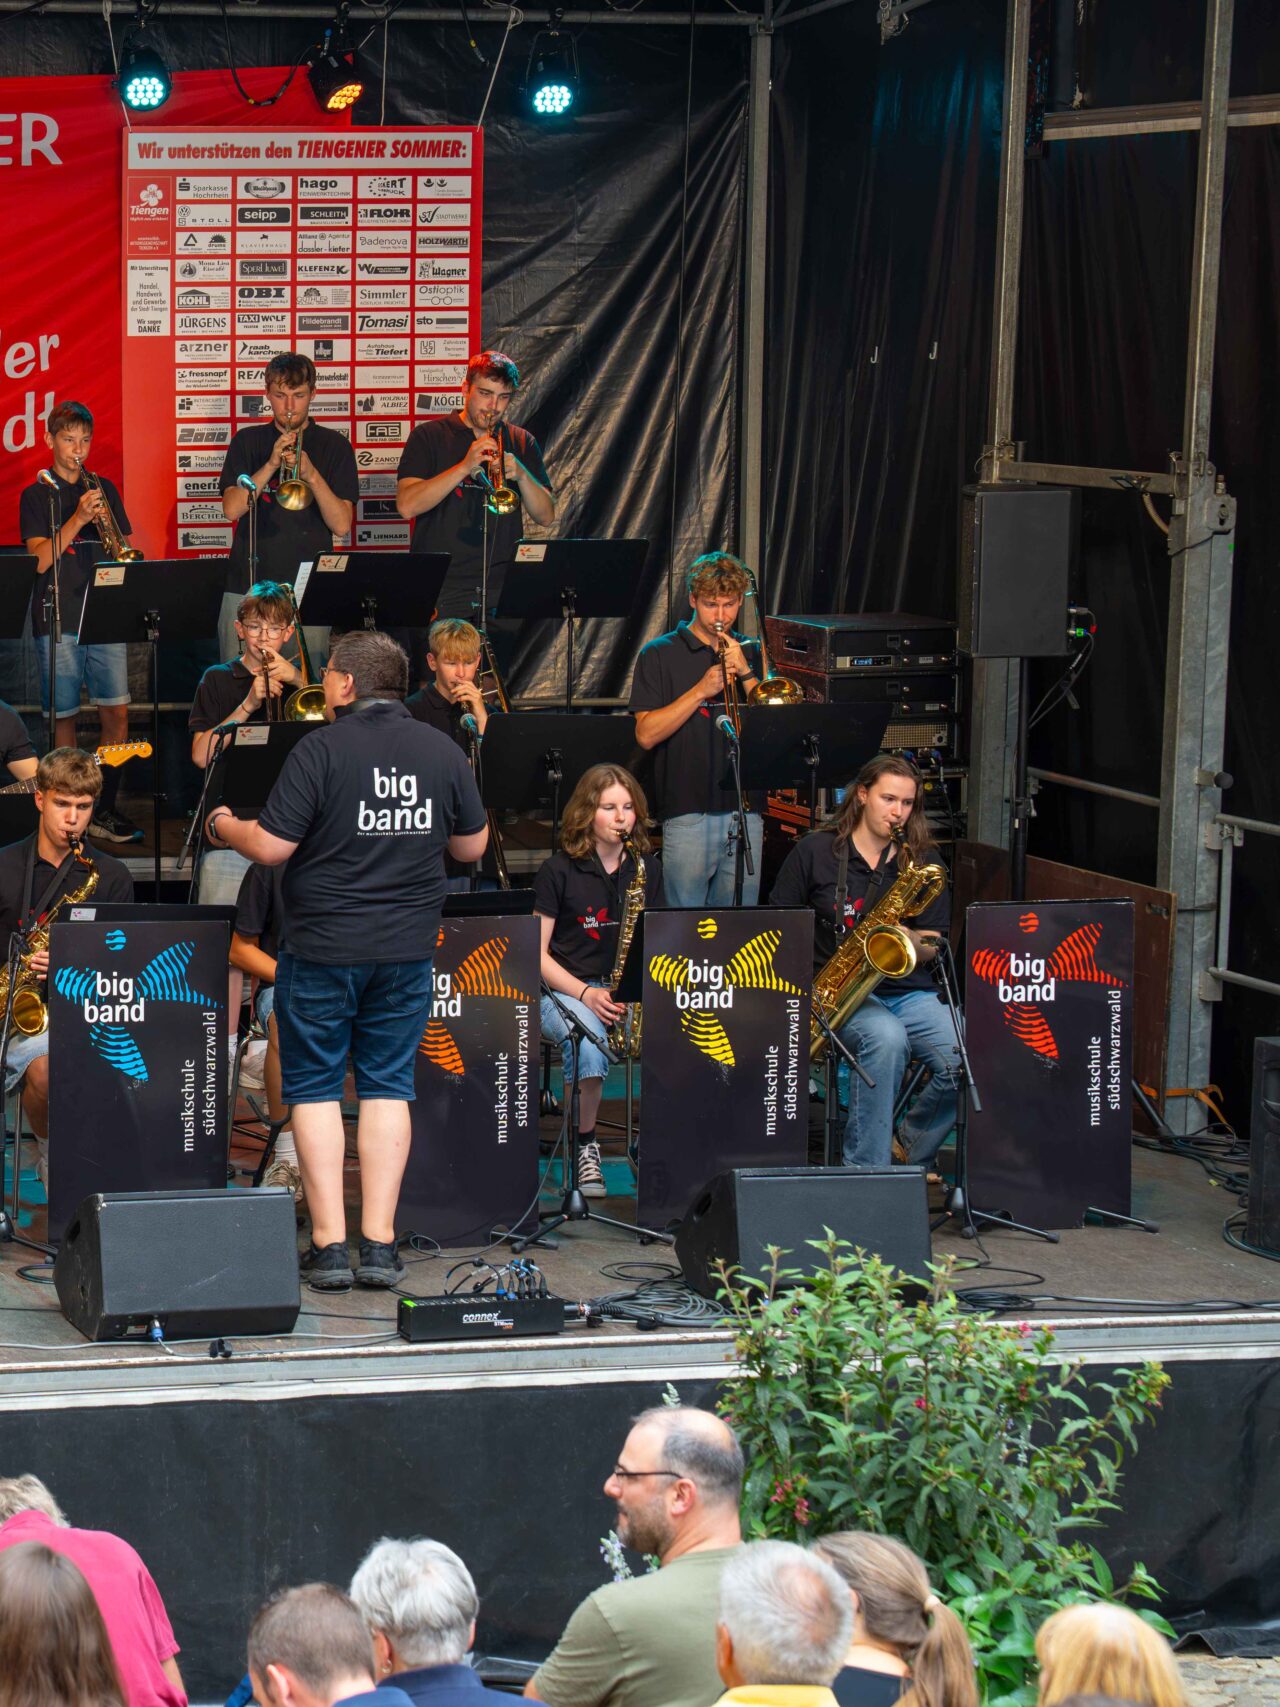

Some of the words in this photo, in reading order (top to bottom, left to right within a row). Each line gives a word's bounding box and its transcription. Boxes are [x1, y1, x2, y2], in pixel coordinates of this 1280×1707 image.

[137, 142, 163, 158] Wir
[167, 142, 260, 159] unterstützen
[265, 143, 292, 158] den
[297, 139, 387, 158] TIENGENER
[390, 139, 467, 158] SOMMER:
[300, 178, 338, 190] hago
[130, 205, 169, 217] Tiengen
[244, 209, 277, 221] seipp
[310, 210, 346, 218] SCHLEITH
[369, 208, 411, 218] FLOHR
[328, 240, 350, 252] kiefer
[418, 238, 468, 246] HOLZWARTH
[432, 266, 466, 277] Wagner
[238, 287, 285, 298] OBI
[360, 289, 407, 299] Simmler
[419, 285, 464, 295] Ostioptik
[179, 315, 227, 328] JÜRGENS
[238, 314, 259, 322] TAXI
[358, 315, 408, 332] Tomasi
[416, 316, 433, 325] sto
[180, 343, 228, 352] arzner
[189, 370, 227, 378] fressnapf
[178, 428, 228, 442] 2000
[367, 423, 401, 436] FAB
[373, 767, 418, 806] big
[357, 798, 432, 831] band
[688, 959, 723, 989] big
[1010, 953, 1045, 983] big
[96, 971, 134, 1002] big
[432, 968, 451, 999] ig
[999, 978, 1055, 1002] band
[428, 993, 462, 1018] nd
[676, 985, 734, 1009] band
[84, 997, 144, 1023] band
[1107, 990, 1121, 1110] südschwarzwald
[515, 1004, 528, 1127] südschwarzwald
[784, 1000, 800, 1120] südschwarzwald
[202, 1012, 216, 1136] südschwarzwald
[1088, 1036, 1101, 1126] musikschule
[494, 1052, 509, 1144] musikschule
[764, 1045, 778, 1136] musikschule
[181, 1059, 195, 1152] musikschule
[463, 1313, 498, 1321] connex
